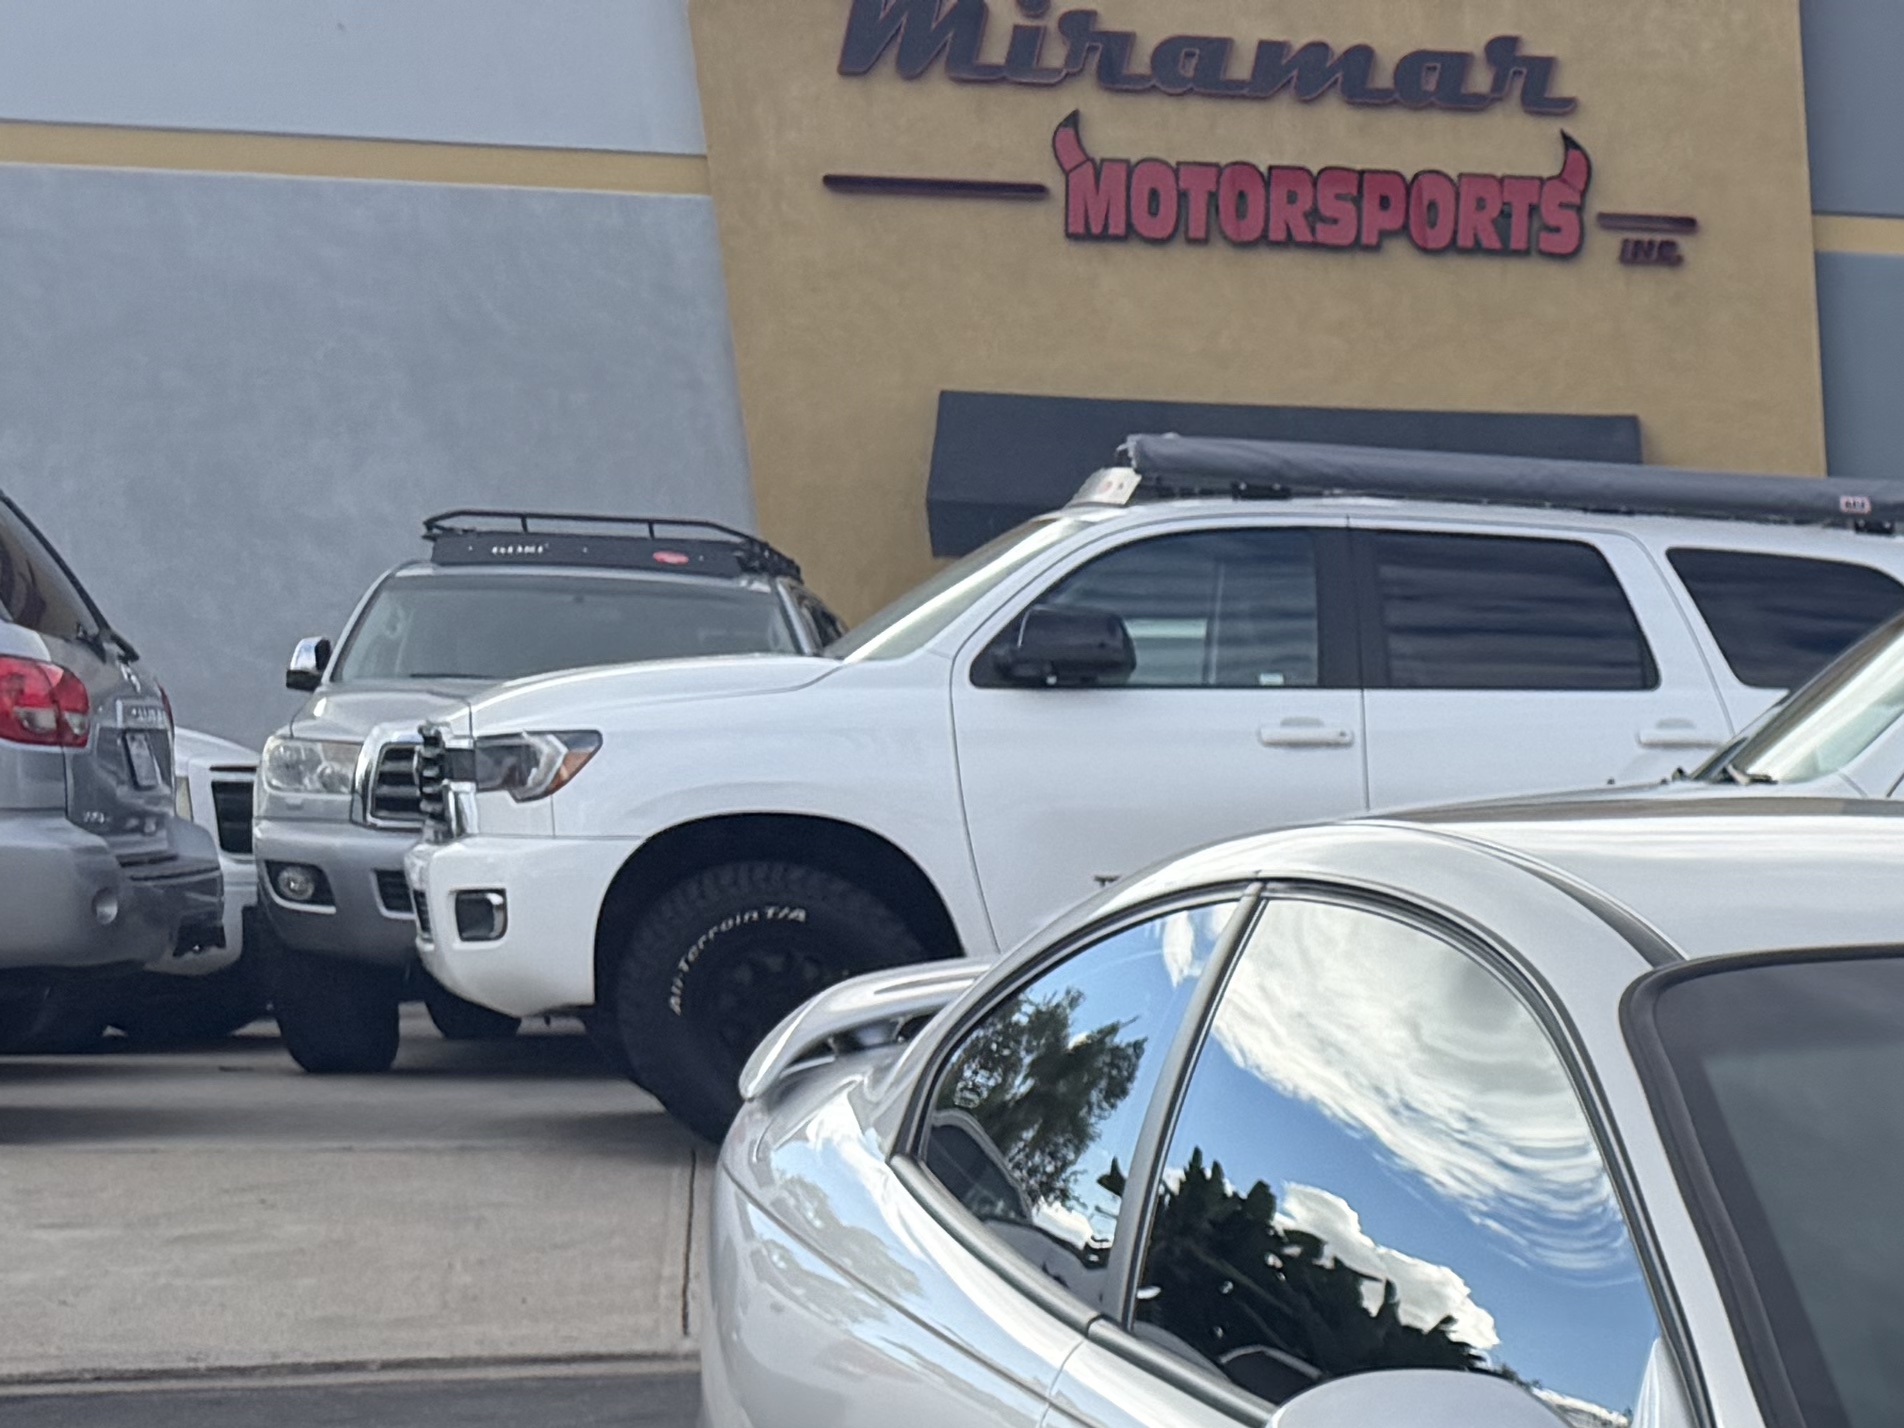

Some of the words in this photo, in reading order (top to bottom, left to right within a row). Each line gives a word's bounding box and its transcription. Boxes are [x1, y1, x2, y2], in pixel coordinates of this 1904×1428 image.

[837, 0, 1577, 115] Miramar
[1060, 145, 1589, 259] MOTORSPORTS
[764, 905, 806, 922] T/A
